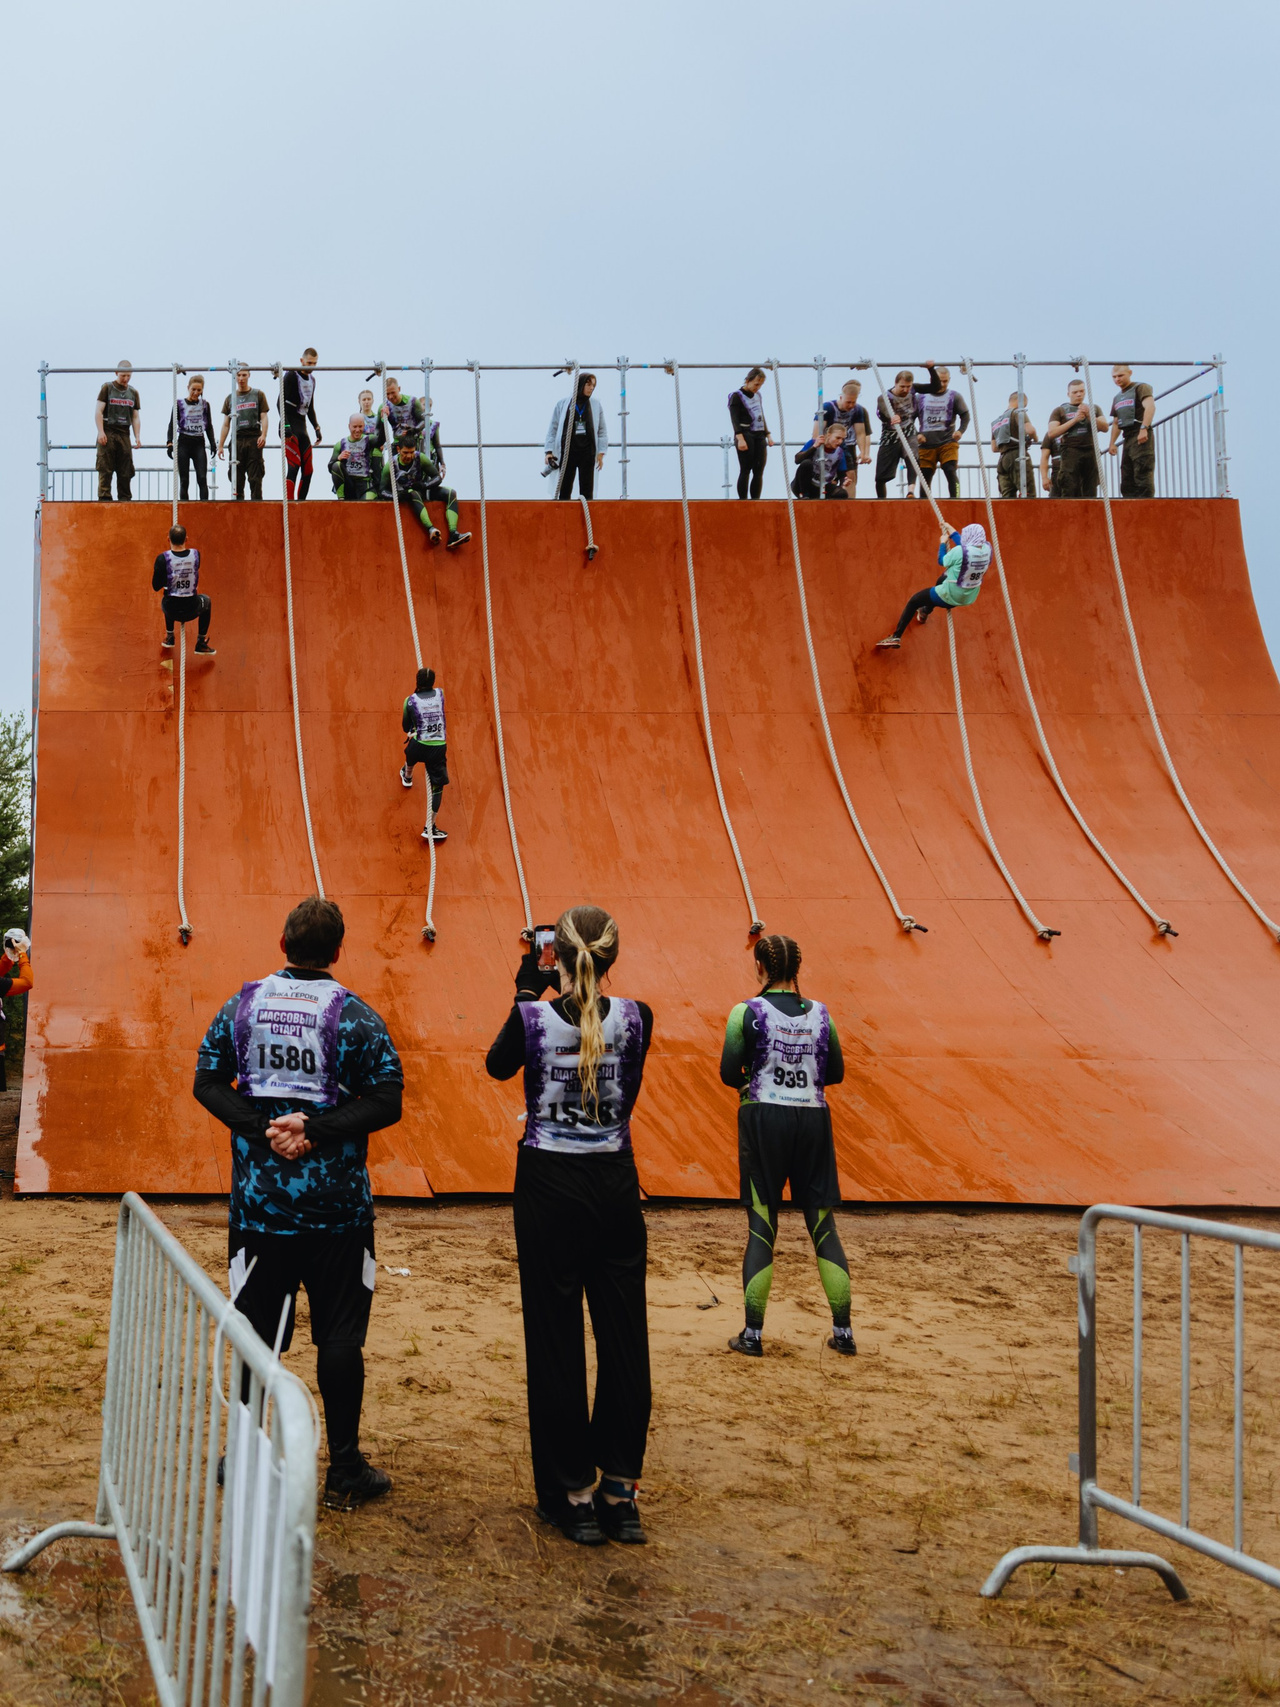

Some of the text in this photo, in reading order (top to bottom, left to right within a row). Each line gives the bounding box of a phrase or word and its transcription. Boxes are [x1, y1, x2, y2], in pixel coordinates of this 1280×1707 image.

[290, 992, 319, 1002] ГЕРОЕВ
[259, 1010, 316, 1026] МАССОВЫЙ
[272, 1023, 301, 1036] СТАРТ
[257, 1043, 317, 1075] 1580
[773, 1066, 808, 1089] 939
